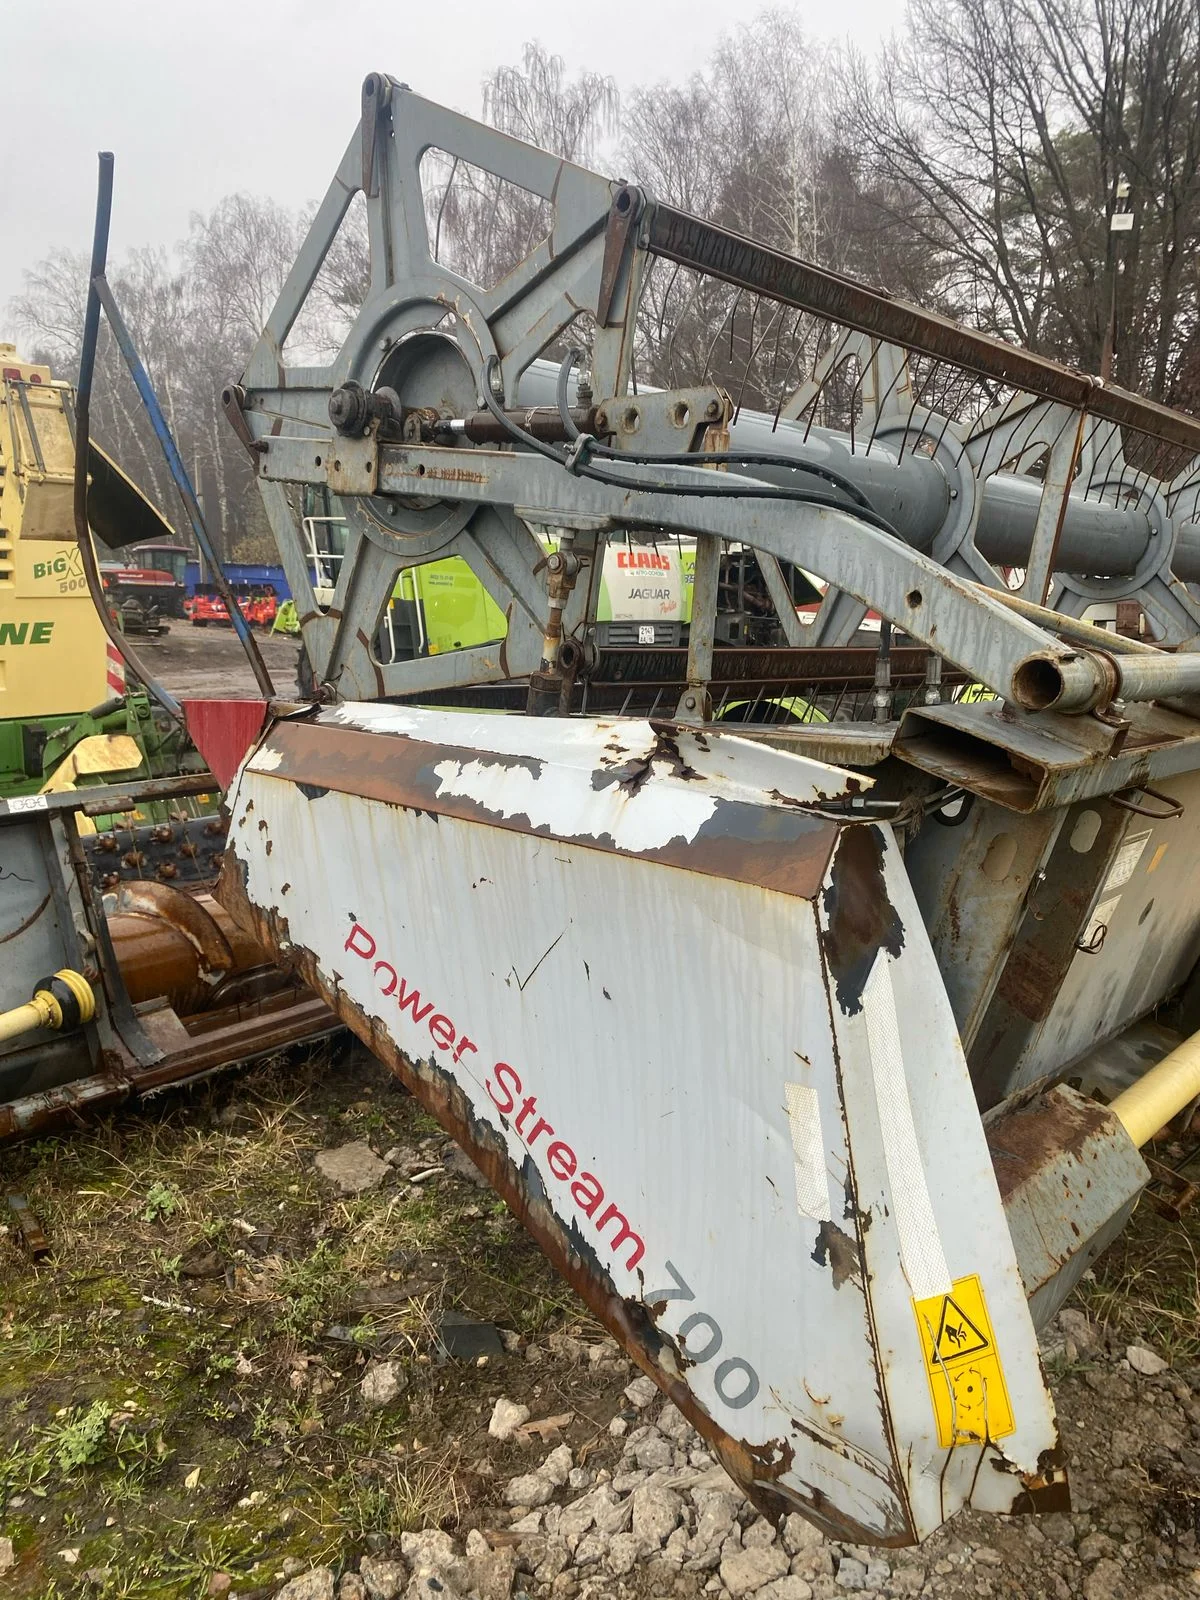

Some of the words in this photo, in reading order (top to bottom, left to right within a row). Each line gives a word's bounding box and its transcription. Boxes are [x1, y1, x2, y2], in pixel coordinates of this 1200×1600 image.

[617, 552, 671, 571] CLAAS
[59, 577, 87, 594] 500
[628, 588, 671, 600] JAGUAR
[344, 922, 478, 1064] Power
[485, 1062, 646, 1272] Stream
[644, 1260, 760, 1409] 700
